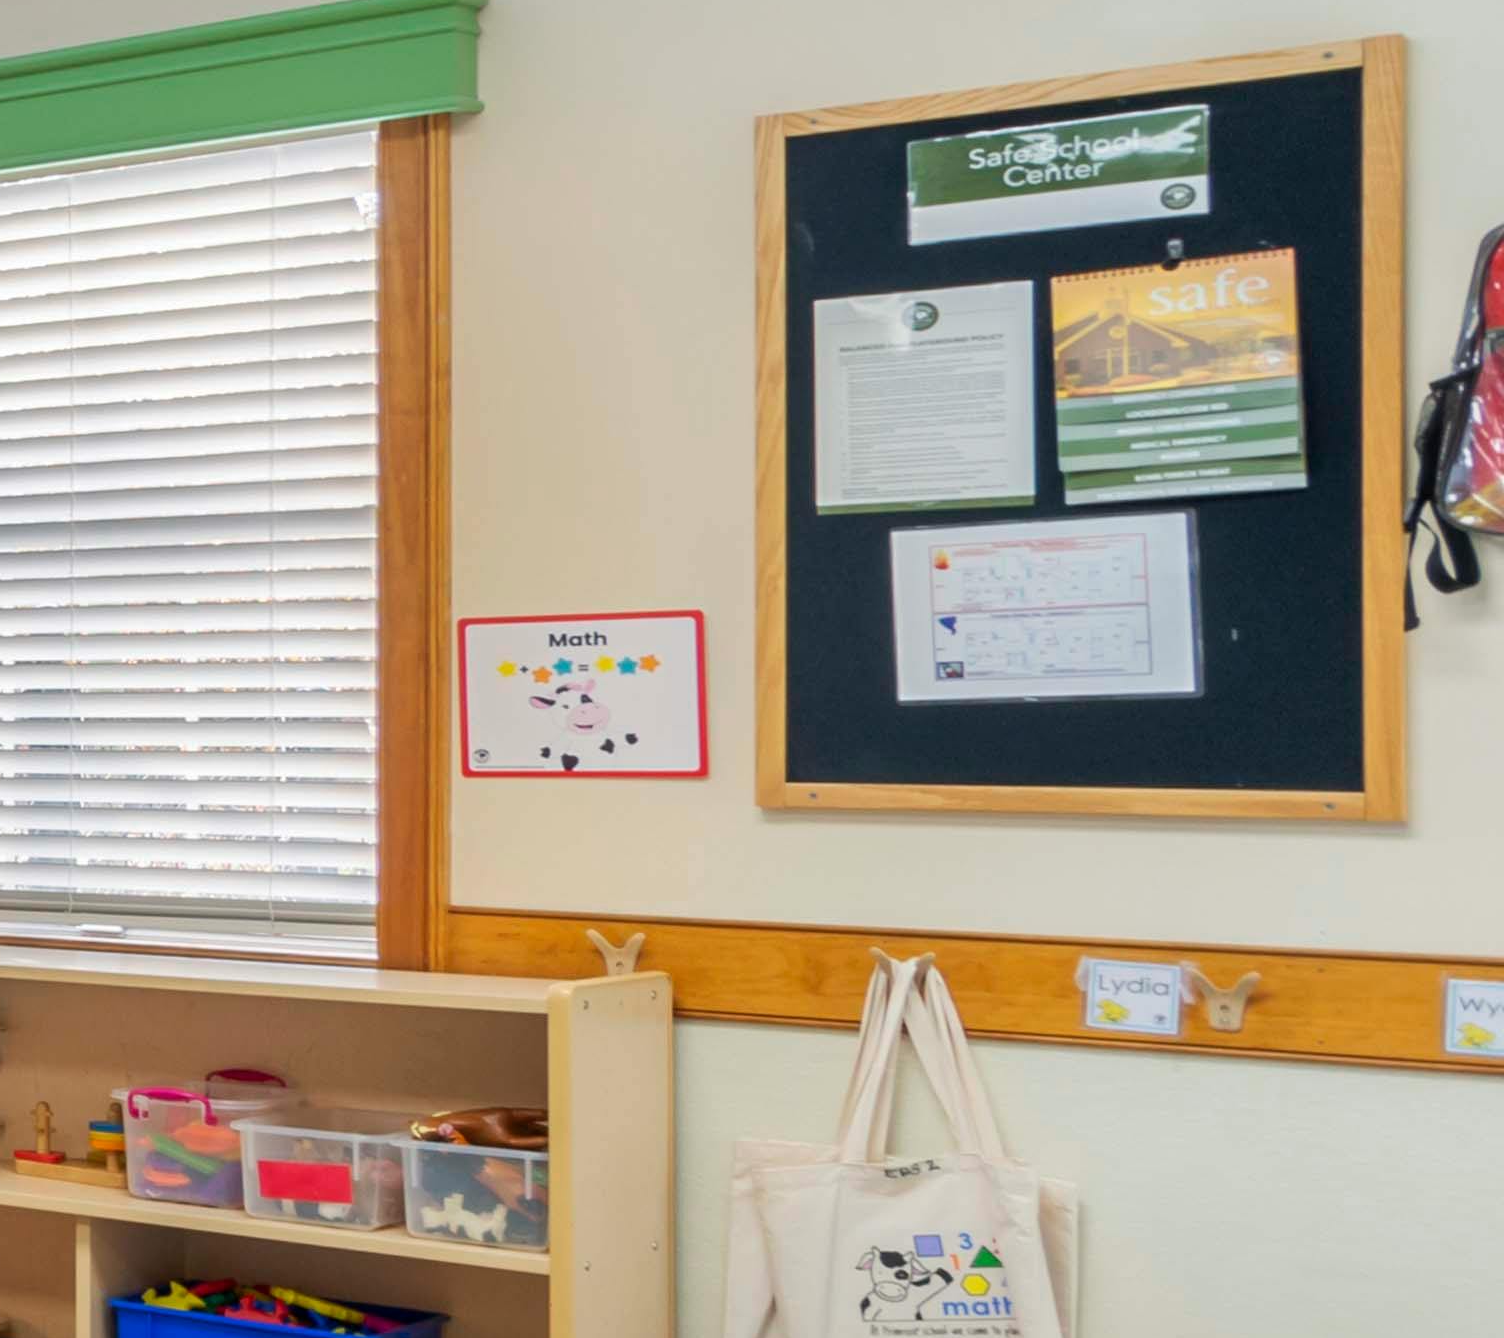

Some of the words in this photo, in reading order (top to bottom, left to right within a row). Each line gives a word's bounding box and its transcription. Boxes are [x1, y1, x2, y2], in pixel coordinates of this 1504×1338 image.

[968, 143, 1033, 170] Safe
[1046, 127, 1139, 161] School
[1003, 161, 1104, 187] Center
[1149, 268, 1269, 316] safe
[548, 631, 608, 647] Math
[1098, 974, 1170, 998] Lydia
[1459, 996, 1504, 1019] Wy
[958, 1232, 974, 1250] 3
